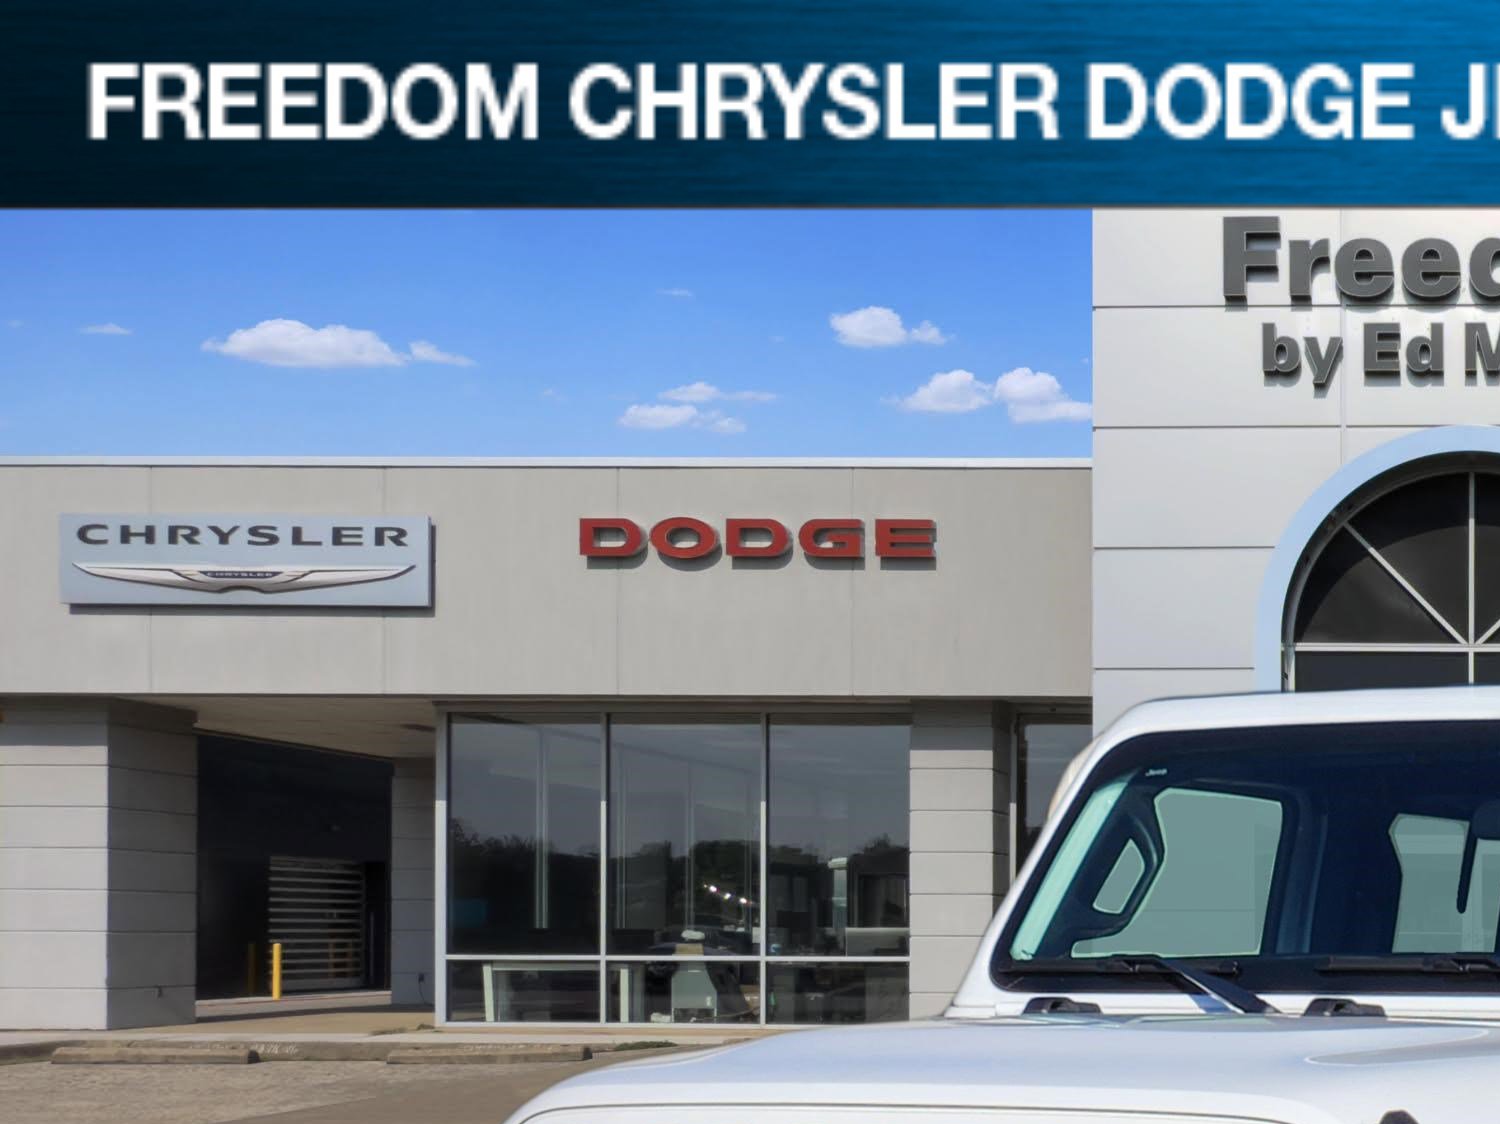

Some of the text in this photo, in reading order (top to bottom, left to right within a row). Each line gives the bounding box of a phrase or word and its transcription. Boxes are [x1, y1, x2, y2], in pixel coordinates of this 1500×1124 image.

[1262, 322, 1344, 386] by
[1363, 322, 1444, 375] Ed
[75, 522, 410, 549] CHRYSLER
[578, 516, 937, 561] DODGE
